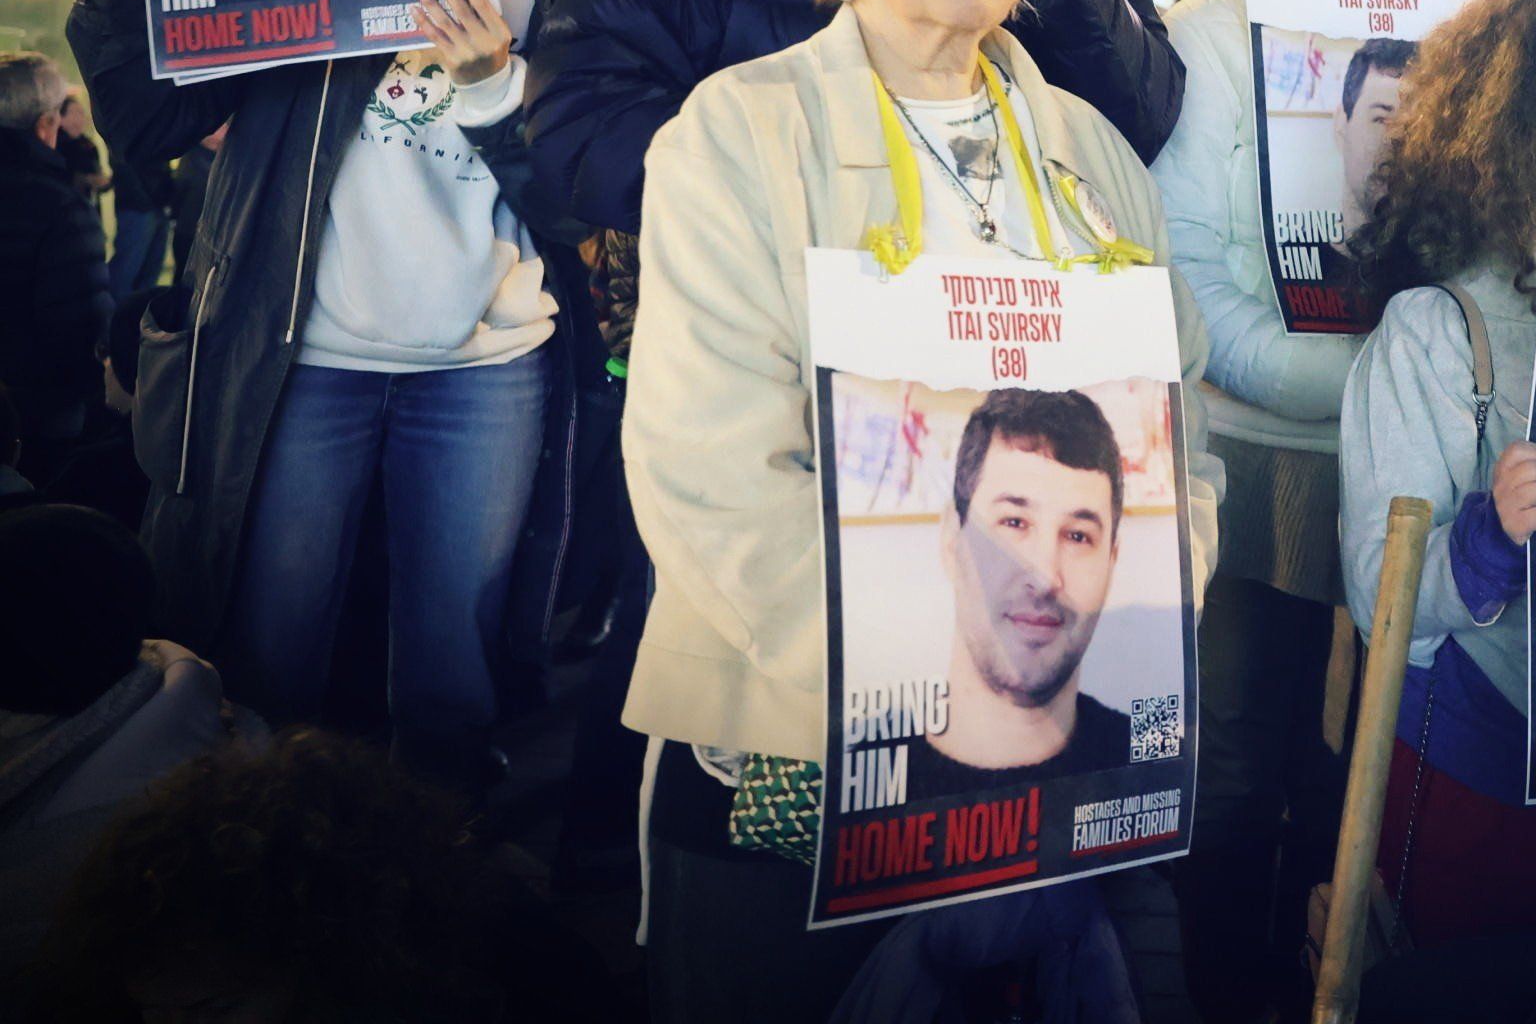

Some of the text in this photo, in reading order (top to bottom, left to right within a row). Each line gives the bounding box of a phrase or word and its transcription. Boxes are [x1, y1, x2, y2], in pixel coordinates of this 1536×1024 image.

[163, 11, 246, 54] HOME
[1369, 11, 1394, 34] (38)
[1274, 208, 1345, 244] BRING
[1277, 245, 1323, 280] HIM
[941, 274, 1063, 308] איתי סבירסקי
[948, 311, 1062, 342] ITAI SVIRSKY
[991, 345, 1027, 381] (38)
[842, 677, 950, 747] BRING
[840, 744, 909, 814] HIM
[1074, 788, 1181, 825] HOSTAGES AND MISSING
[834, 787, 1041, 888] HOME NOW!
[1072, 806, 1180, 852] FAMILIES FORUM
